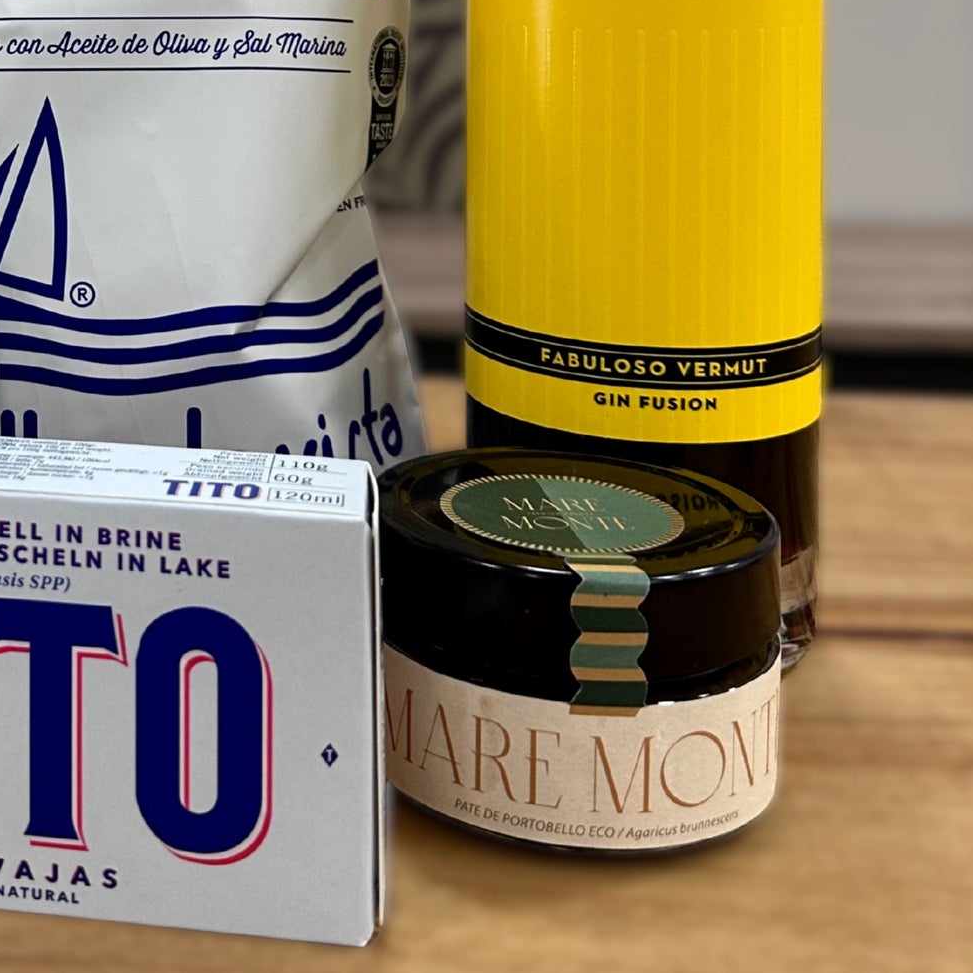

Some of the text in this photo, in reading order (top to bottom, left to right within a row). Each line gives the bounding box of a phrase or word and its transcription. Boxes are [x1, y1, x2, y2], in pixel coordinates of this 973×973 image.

[6, 37, 44, 56] con
[47, 31, 119, 56] Aceite
[121, 32, 149, 56] de
[152, 30, 211, 56] Oliva
[212, 35, 229, 60] y
[233, 29, 272, 59] Sal
[276, 32, 347, 58] Marina
[540, 347, 768, 377] FABULOSO VERMUT
[593, 391, 718, 412] GIN FUSION
[279, 459, 329, 473] 110g
[163, 479, 262, 500] TITO
[274, 473, 315, 486] 60g
[274, 490, 340, 505] 120ml
[55, 524, 82, 544] IN
[97, 527, 183, 552] BRINE
[117, 552, 144, 573] IN
[159, 555, 232, 579] LAKE
[29, 572, 71, 593] SPP)
[590, 689, 779, 814] MONT
[454, 798, 482, 817] PATE
[484, 807, 500, 822] DE
[502, 813, 585, 838] PORTOBELLO
[589, 825, 615, 839] ECO
[625, 825, 678, 841] Agaricus
[679, 808, 740, 835] brunnescens
